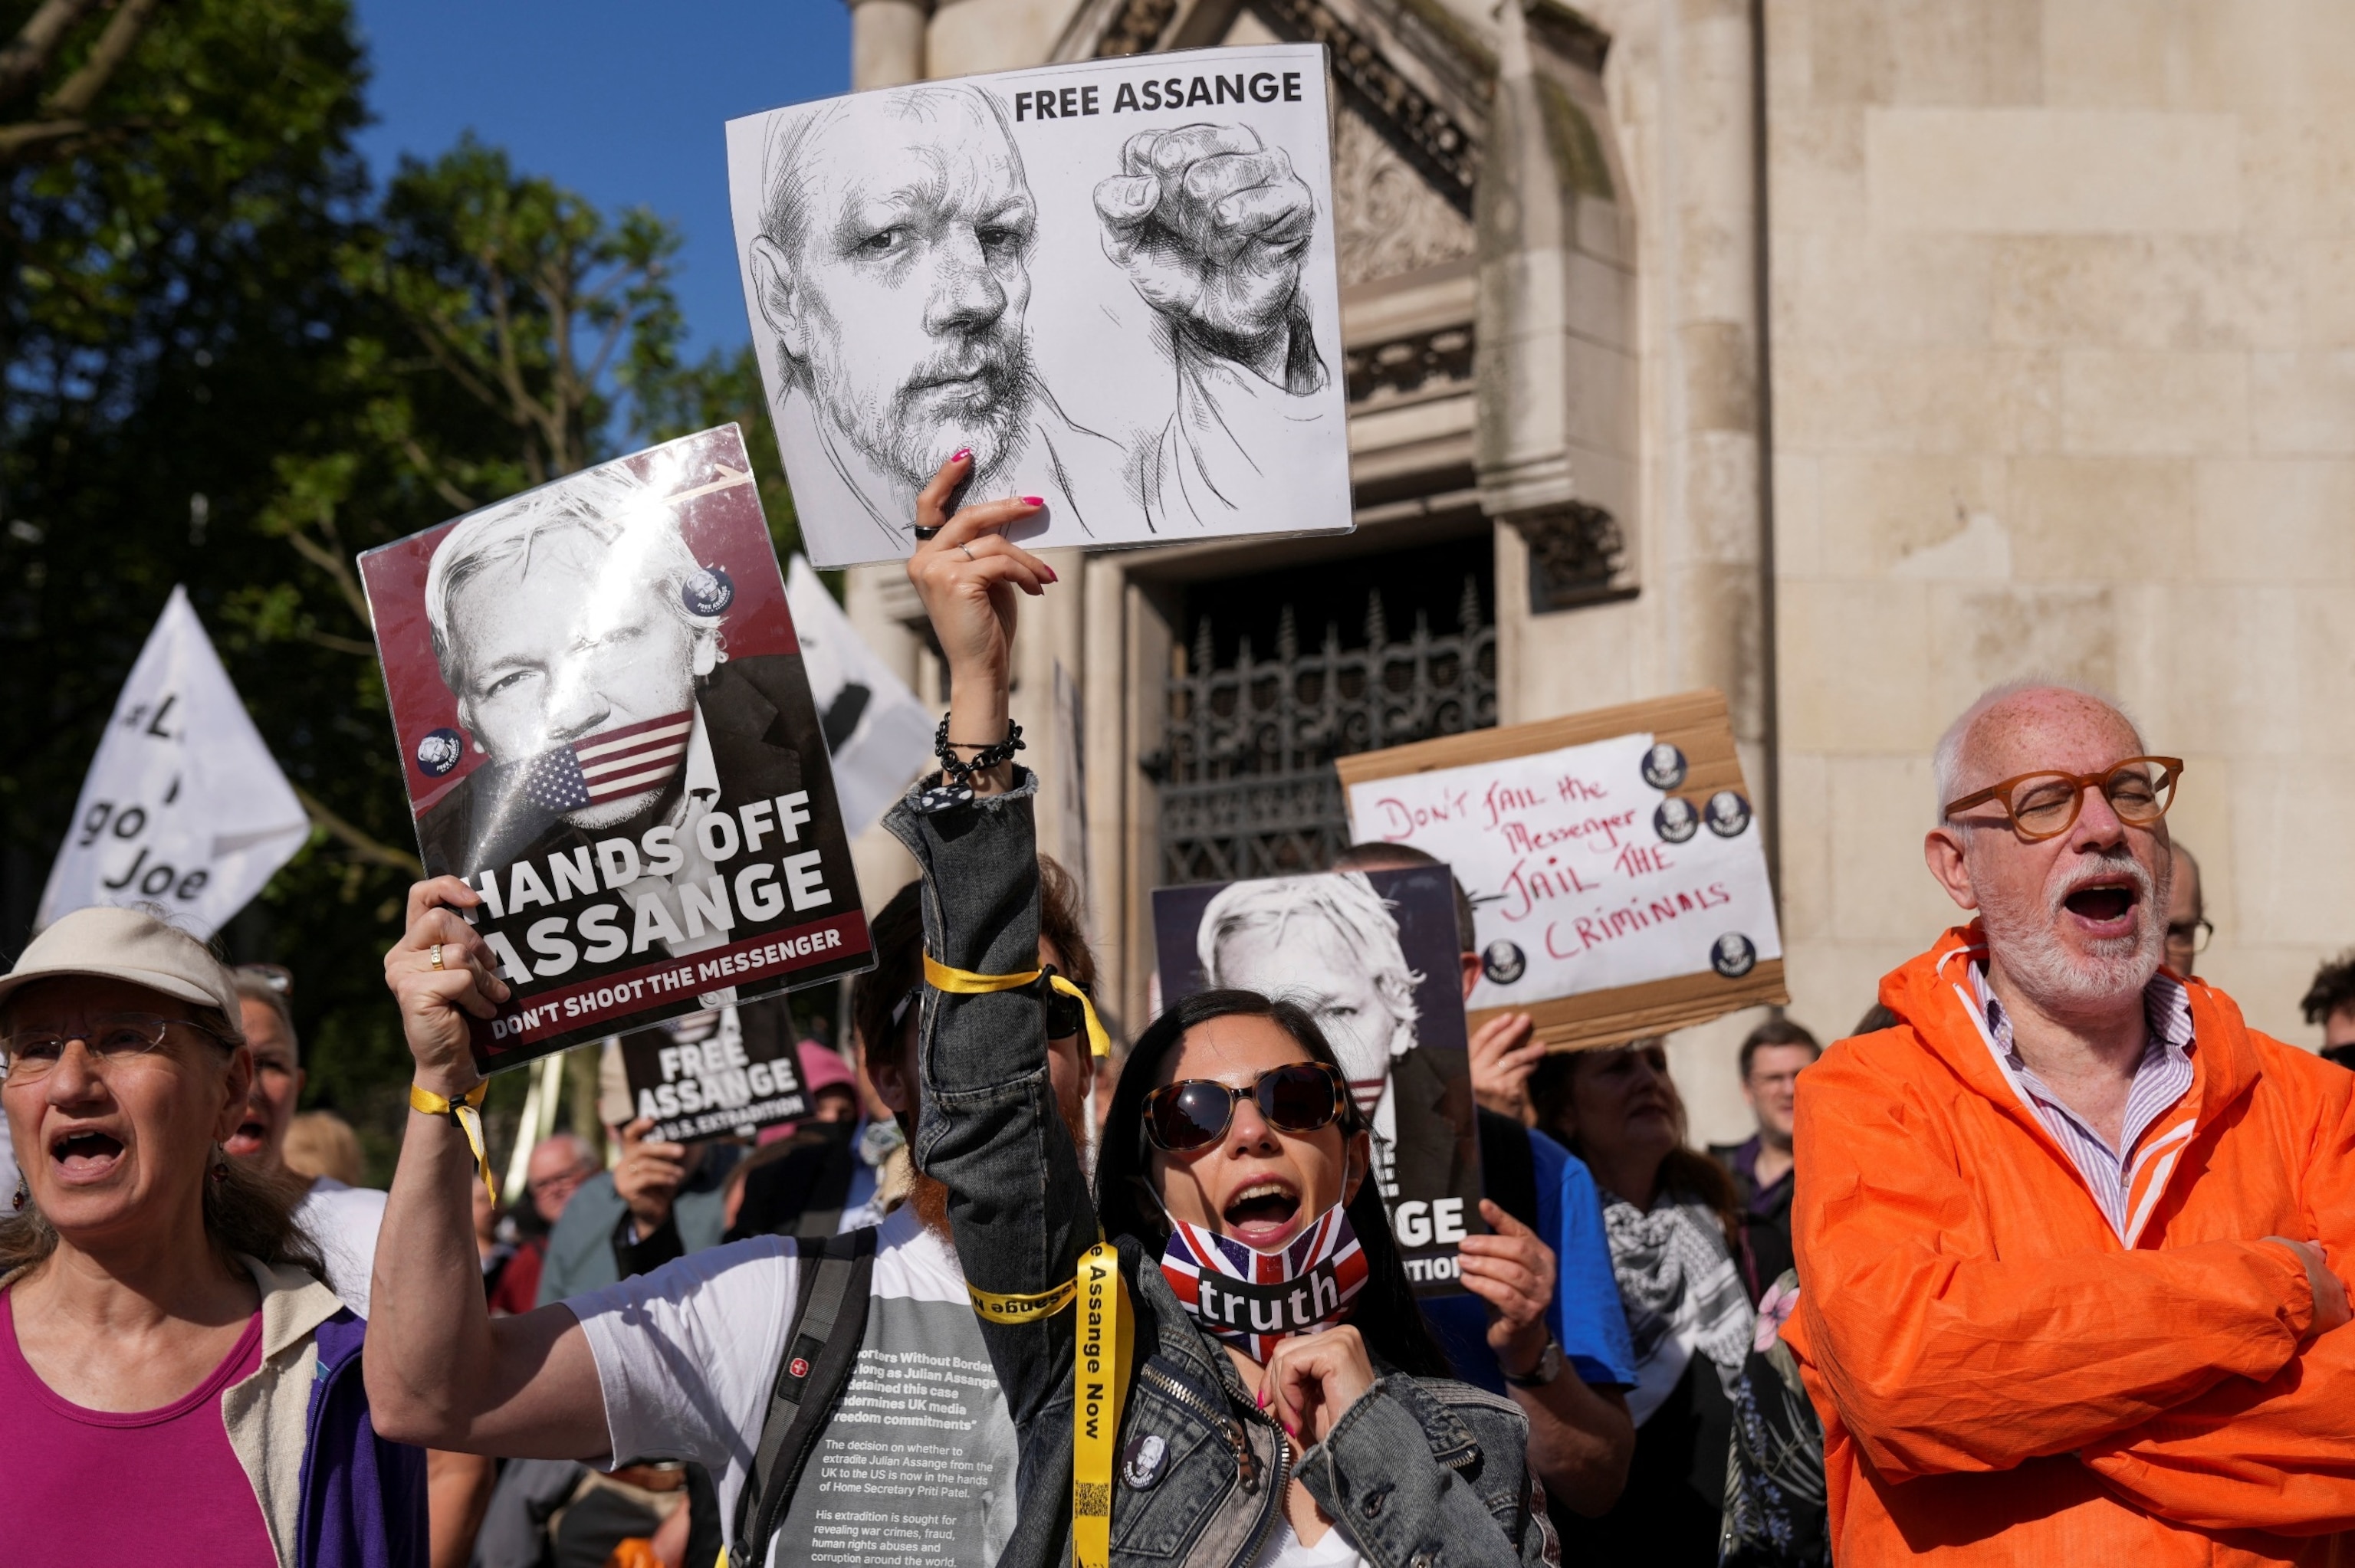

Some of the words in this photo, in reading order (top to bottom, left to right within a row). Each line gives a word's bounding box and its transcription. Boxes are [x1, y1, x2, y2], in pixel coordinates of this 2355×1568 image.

[1015, 85, 1099, 122] FREE
[1112, 72, 1302, 113] ASSANGE
[1376, 787, 1469, 841] DON'T
[460, 825, 684, 925] HANDS
[696, 790, 810, 861] OFF
[1614, 841, 1675, 878] THE
[103, 848, 209, 900] Joe
[483, 849, 833, 985] ASSANGE
[491, 1002, 559, 1039] DON'T
[563, 979, 645, 1017] SHOOT
[646, 966, 695, 994] THE
[698, 929, 842, 982] MESSENGER
[659, 1036, 749, 1082] FREE
[638, 1057, 798, 1120] ASSANGE
[695, 1095, 804, 1133] EXTRADITION
[1198, 1270, 1338, 1331] truth
[1084, 1265, 1106, 1373] Assange
[859, 1363, 885, 1379] long
[886, 1370, 902, 1378] as
[904, 1368, 942, 1381] Julian
[944, 1372, 998, 1389] Assange
[900, 1352, 951, 1366] Without
[953, 1357, 994, 1372] Border
[903, 1383, 928, 1395] this
[930, 1387, 959, 1399] case
[833, 1411, 882, 1423] reedom
[908, 1399, 927, 1411] UK
[928, 1403, 967, 1415] media
[1086, 1383, 1103, 1439] Now
[823, 1454, 867, 1465] extradite
[869, 1455, 900, 1466] Julian
[902, 1457, 948, 1470] Assange
[950, 1460, 974, 1471] from
[977, 1462, 994, 1471] the
[826, 1439, 845, 1449] The
[847, 1440, 888, 1452] decision
[891, 1444, 904, 1452] on
[907, 1444, 950, 1455] whether
[952, 1447, 963, 1456] to
[819, 1481, 831, 1491] of
[833, 1483, 862, 1492] Home
[864, 1483, 915, 1497] Secretary
[918, 1485, 938, 1496] Priti
[941, 1487, 970, 1498] Patel.
[821, 1468, 837, 1478] UK
[839, 1469, 850, 1478] to
[852, 1469, 868, 1479] the
[870, 1469, 885, 1480] US
[888, 1470, 897, 1480] is
[900, 1472, 922, 1481] now
[925, 1471, 934, 1481] in
[937, 1472, 954, 1483] the
[957, 1474, 988, 1485] hands
[814, 1524, 859, 1537] revealing
[862, 1527, 881, 1536] war
[883, 1527, 921, 1540] crimes,
[925, 1529, 955, 1541] fraud,
[816, 1510, 833, 1520] His
[835, 1511, 888, 1522] extradition
[891, 1513, 900, 1523] is
[902, 1514, 939, 1527] sought
[941, 1514, 957, 1525] for
[811, 1553, 861, 1565] corruption
[864, 1554, 902, 1565] around
[904, 1555, 922, 1566] the
[925, 1557, 957, 1568] world.
[812, 1538, 845, 1548] human
[848, 1539, 877, 1551] rights
[879, 1540, 918, 1552] abuses
[921, 1543, 941, 1553] and
